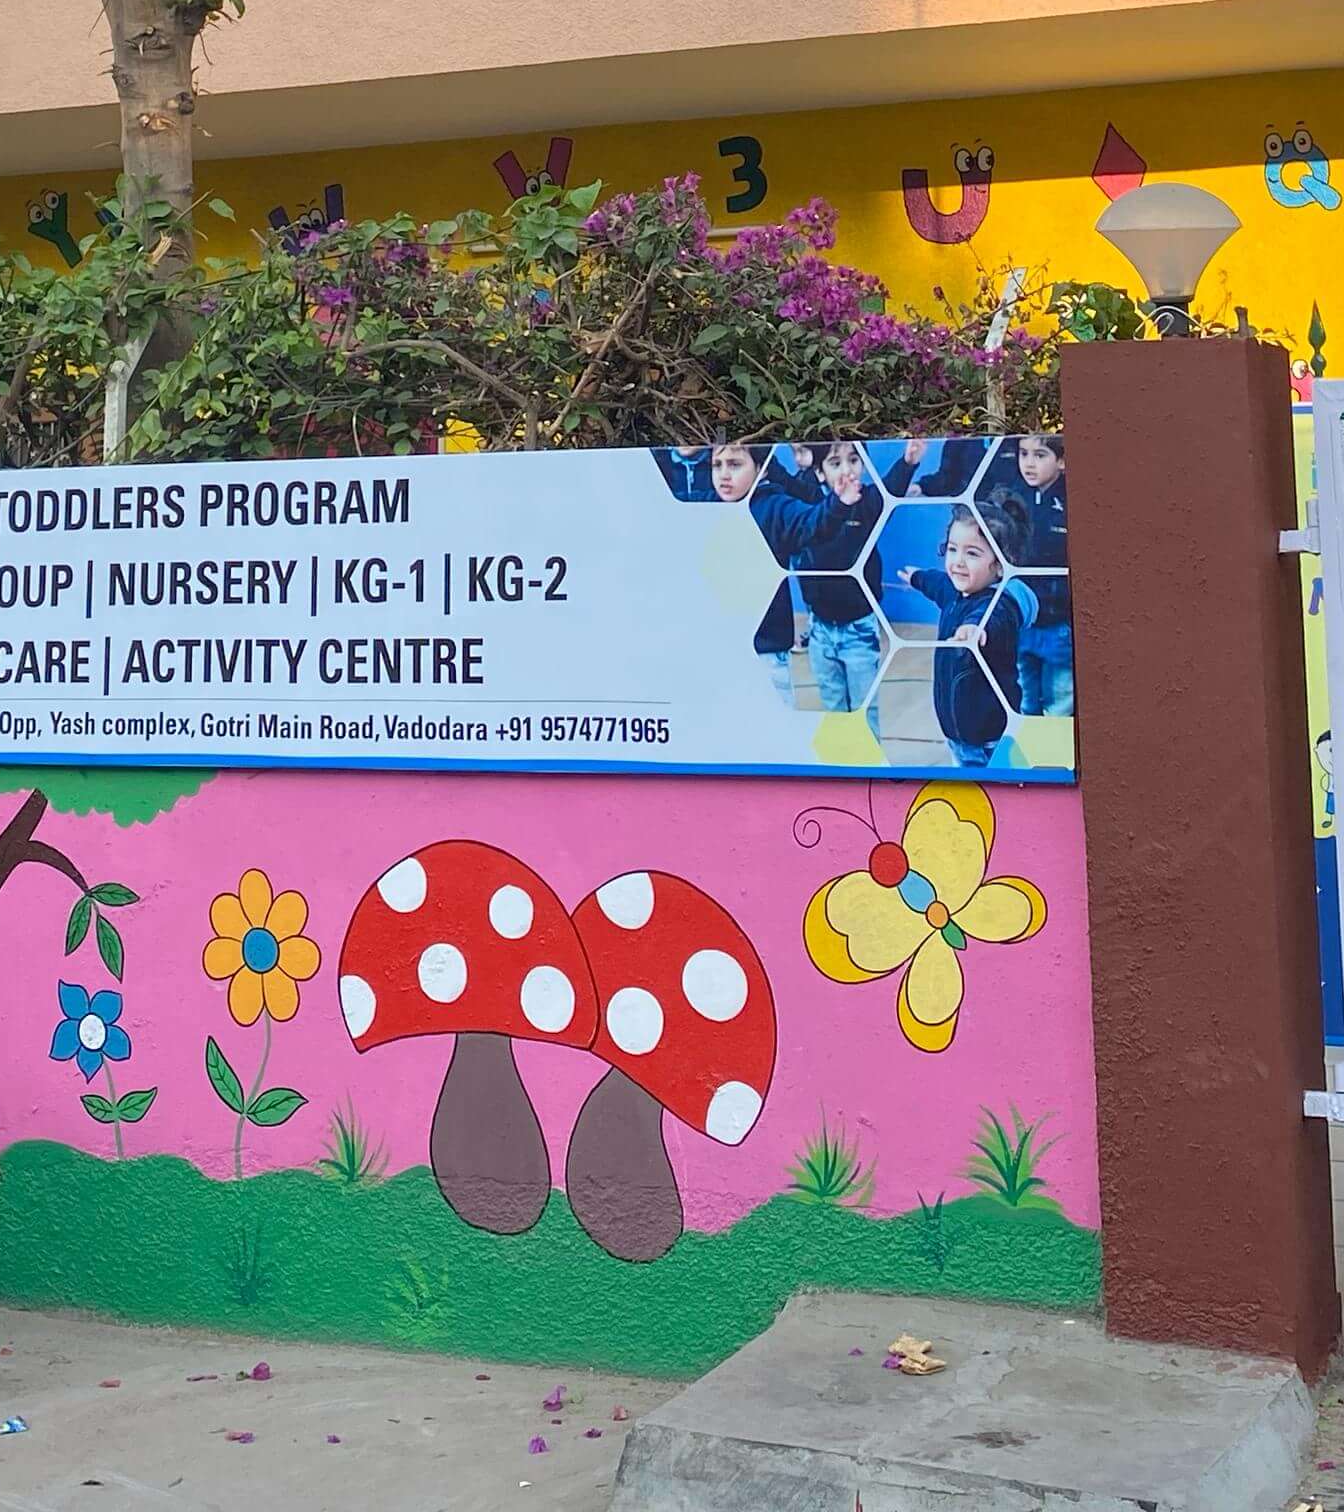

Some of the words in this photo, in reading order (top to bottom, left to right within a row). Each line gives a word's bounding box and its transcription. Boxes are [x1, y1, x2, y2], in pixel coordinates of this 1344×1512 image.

[717, 135, 769, 214] 3
[199, 478, 410, 527] PROGRAM
[107, 560, 298, 606] NURSERY
[333, 557, 425, 604] KG-1
[468, 555, 568, 602] KG-2
[122, 638, 308, 684] ACTIVITY
[318, 638, 484, 684] CENTRE
[0, 710, 43, 740] Opp,
[50, 710, 96, 736] Yash
[102, 711, 196, 741] complex,
[200, 712, 251, 738] Gotri
[258, 713, 312, 740] Main
[319, 714, 381, 743] Road,
[383, 715, 489, 741] Vadodara
[494, 716, 533, 742] +91
[540, 716, 670, 744] 9574771965
